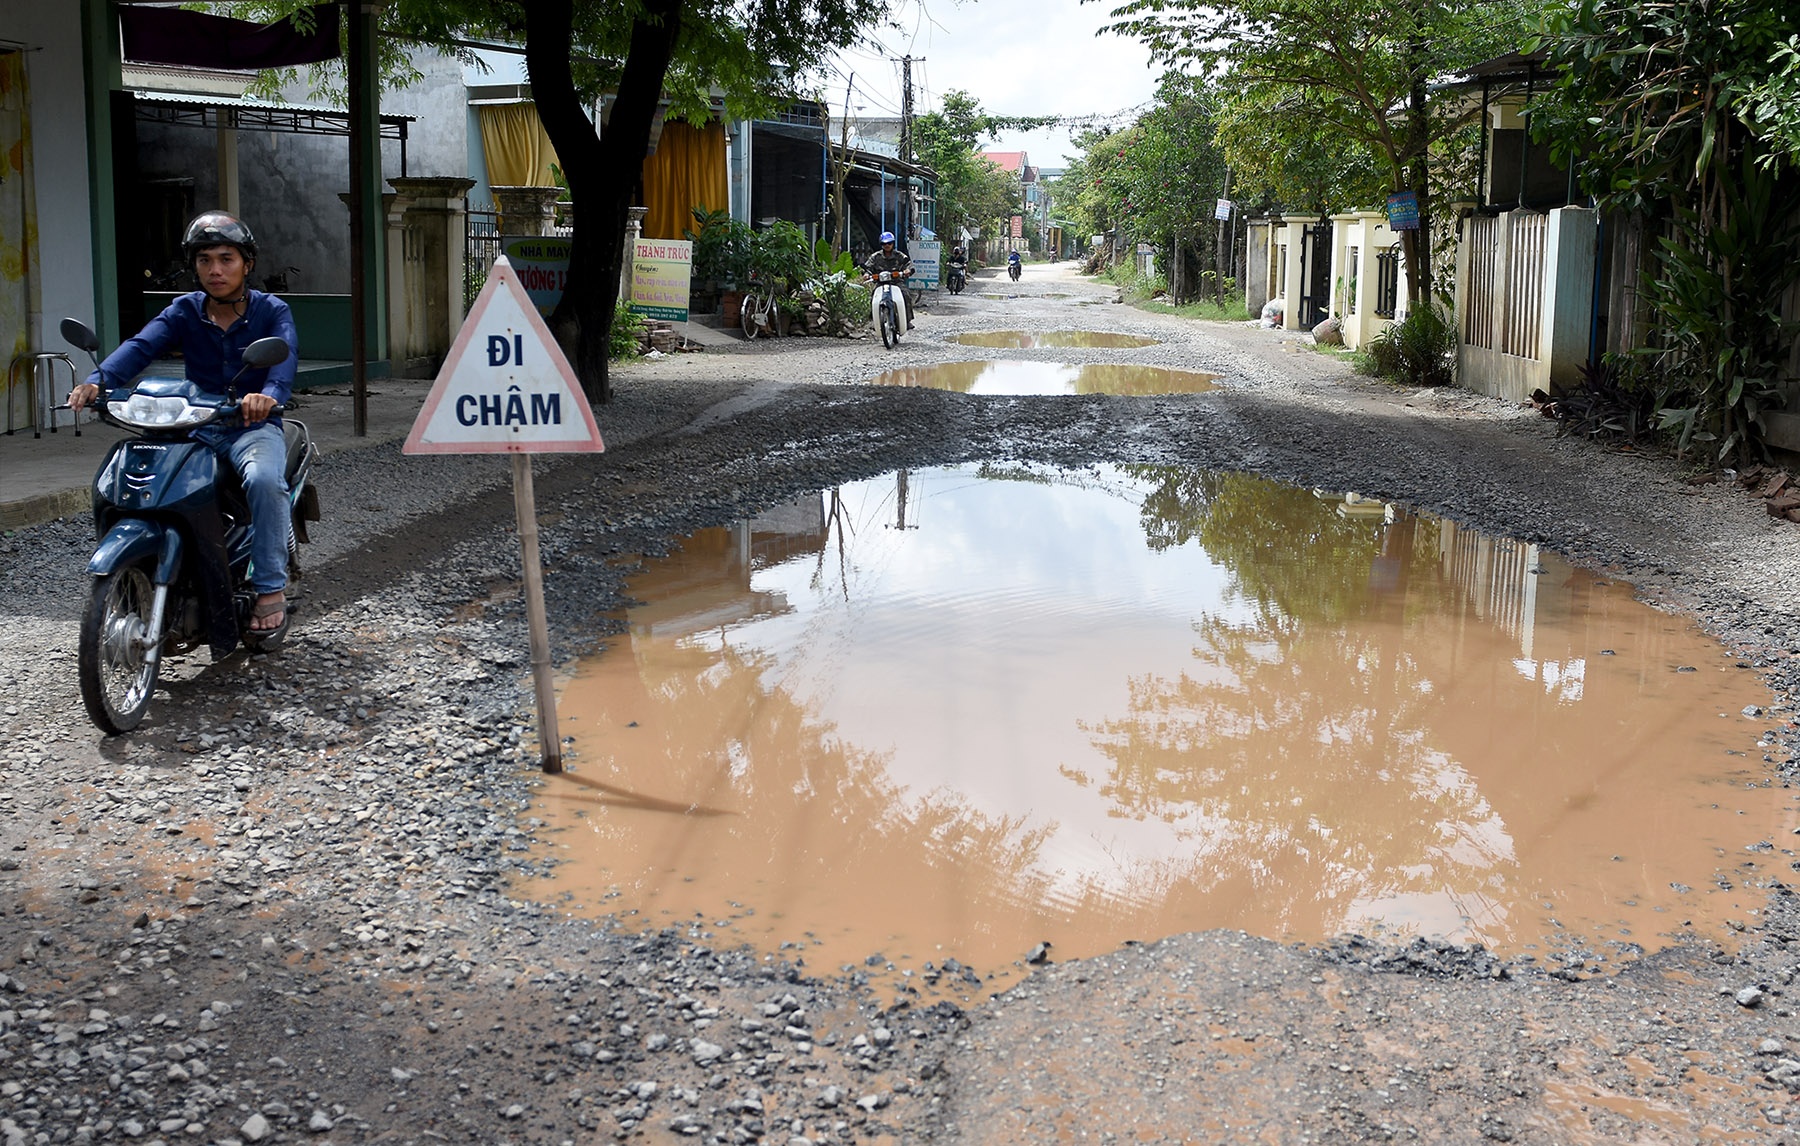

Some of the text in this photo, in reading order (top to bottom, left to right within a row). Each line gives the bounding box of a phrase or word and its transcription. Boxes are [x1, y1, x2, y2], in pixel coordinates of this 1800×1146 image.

[520, 243, 570, 257] NHÀ MAY
[636, 242, 690, 260] THÀNH TRÚC
[486, 334, 523, 367] ĐI
[456, 385, 561, 432] CHẬM
